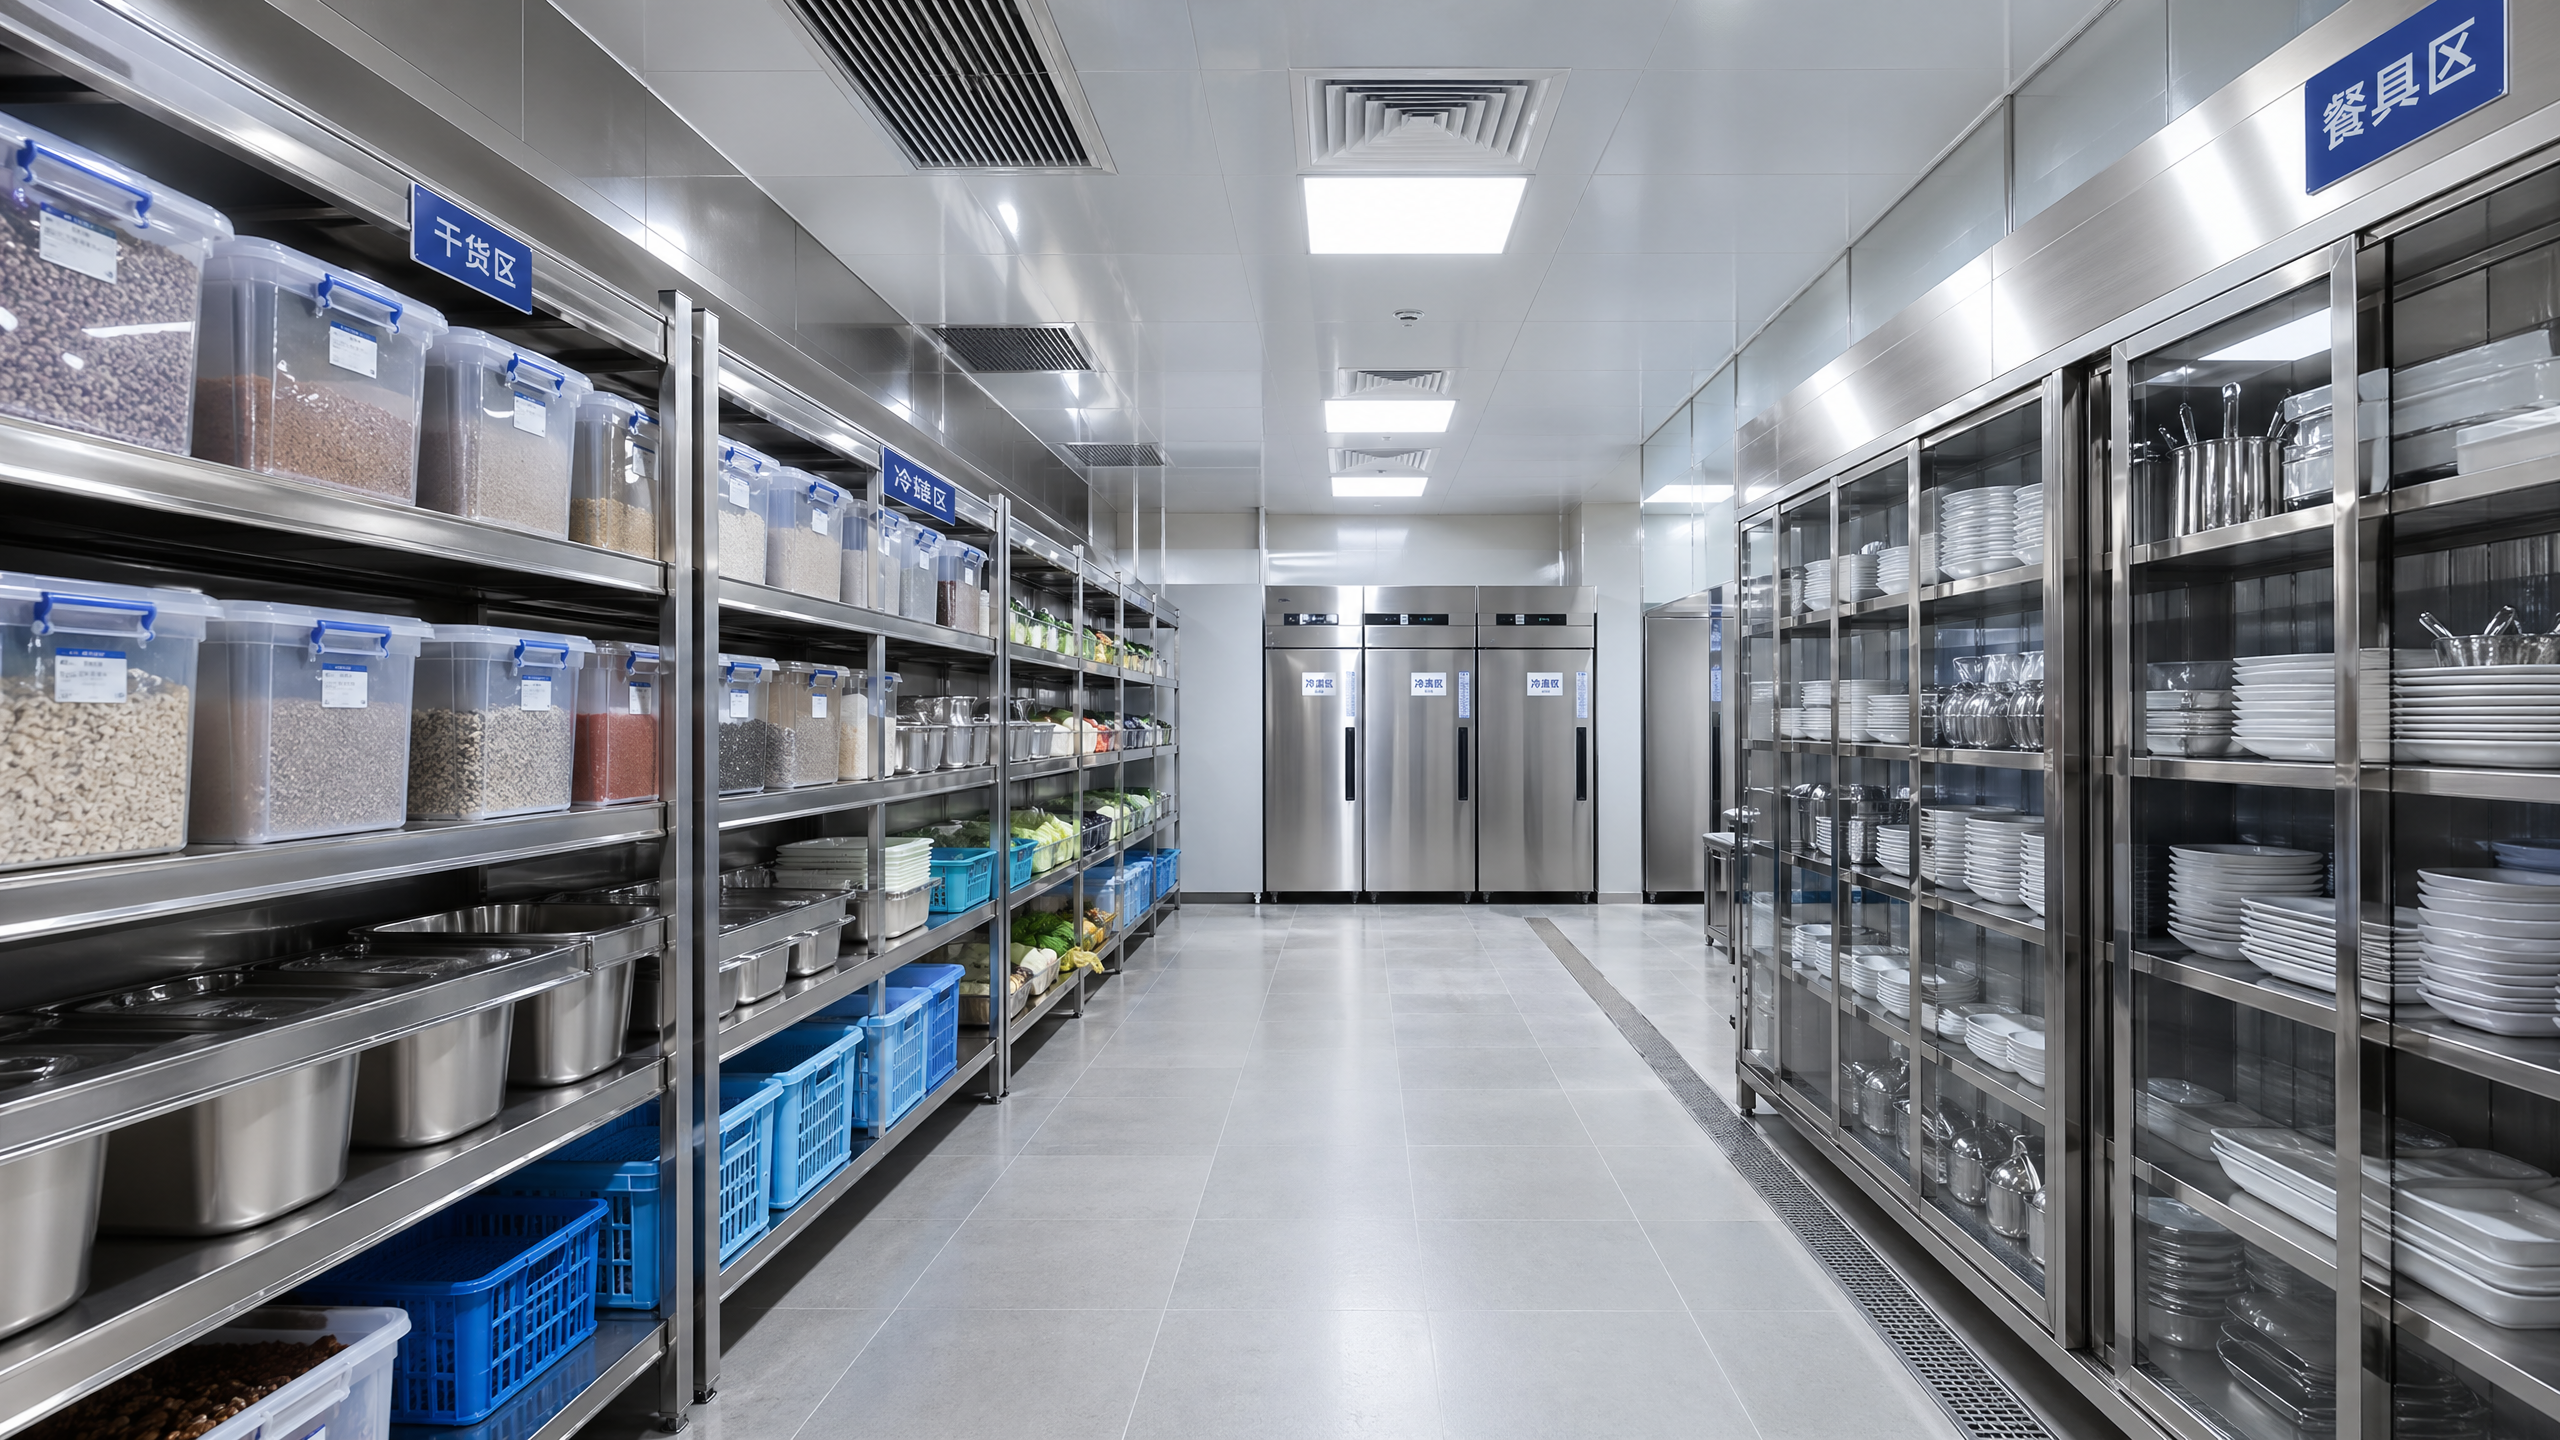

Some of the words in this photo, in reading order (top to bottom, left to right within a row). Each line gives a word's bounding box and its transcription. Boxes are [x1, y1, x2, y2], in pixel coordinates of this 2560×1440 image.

[2323, 16, 2477, 151] 餐具区
[434, 216, 516, 289] 干货区
